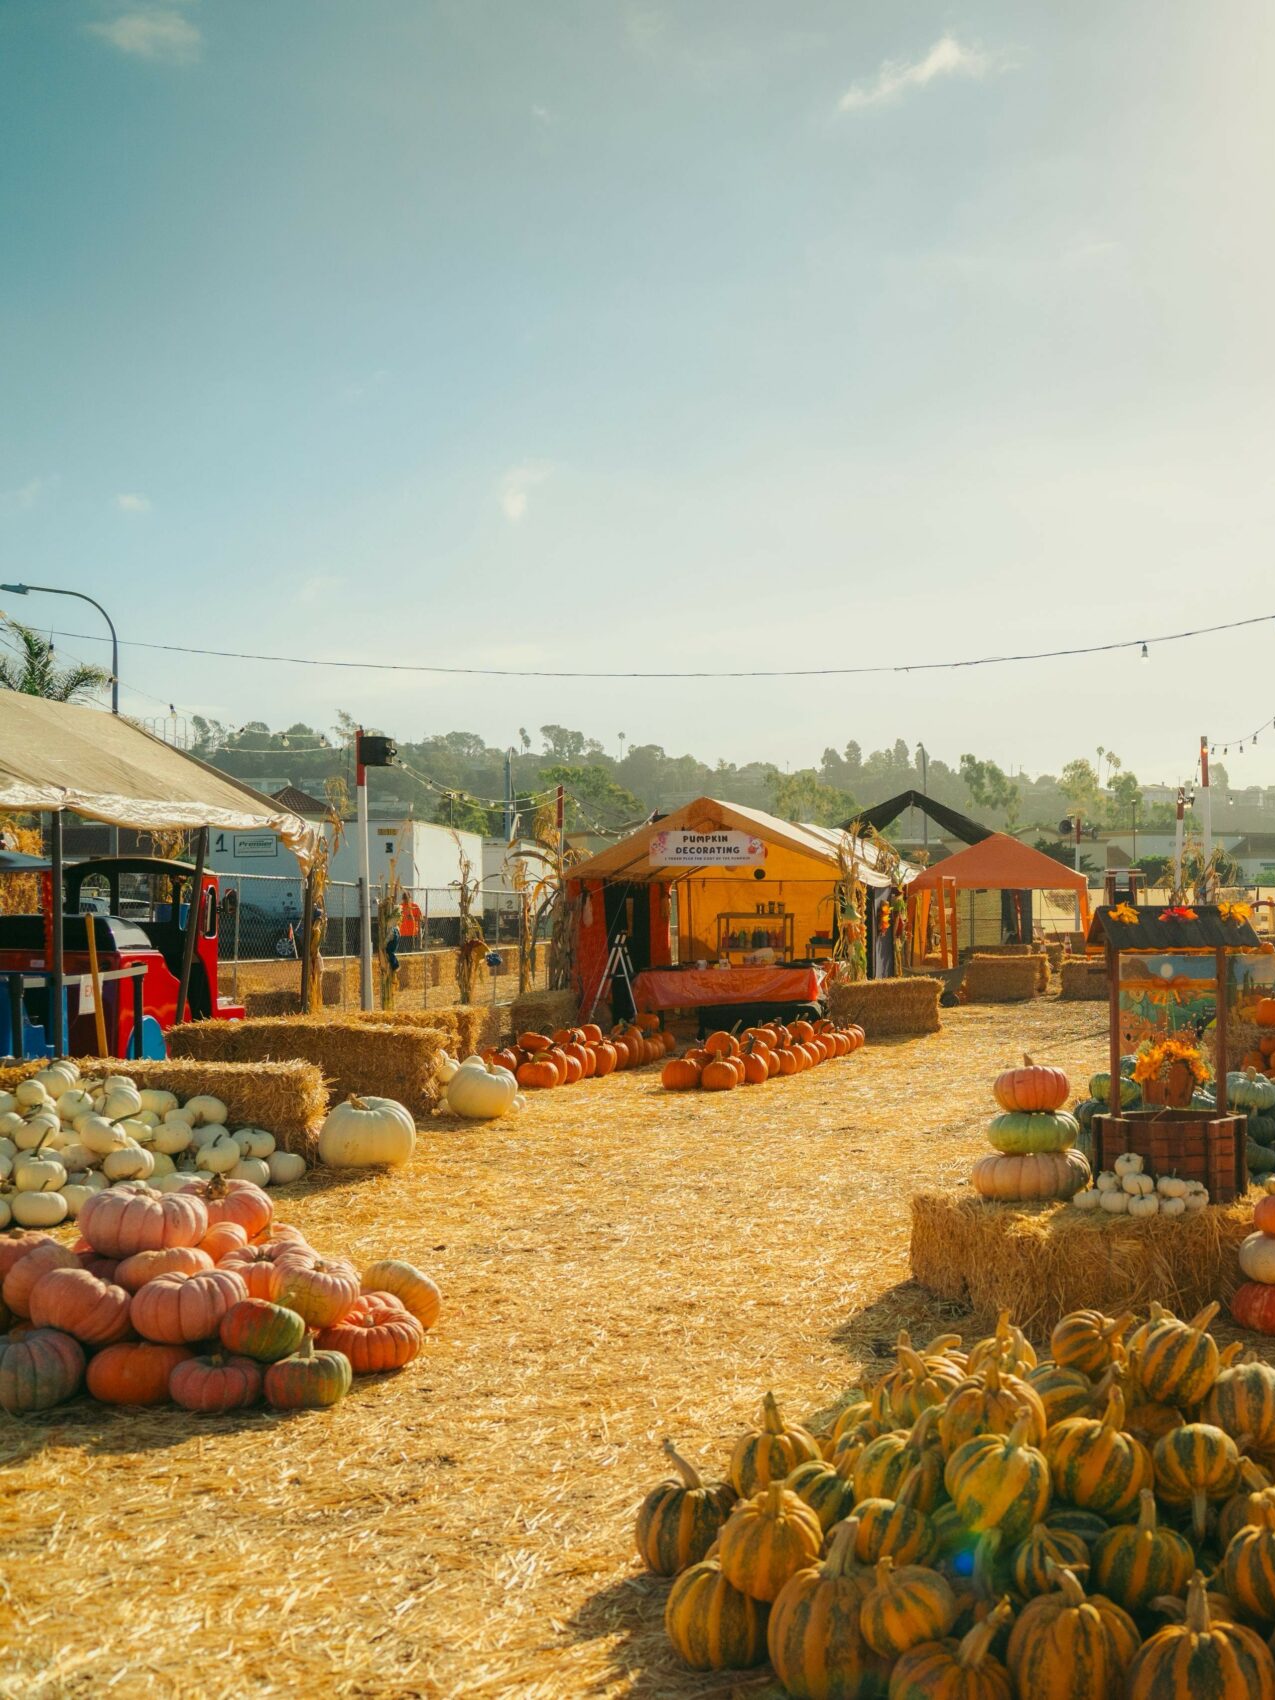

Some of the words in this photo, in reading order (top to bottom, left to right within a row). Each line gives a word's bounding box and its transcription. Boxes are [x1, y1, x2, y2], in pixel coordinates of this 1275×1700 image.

[215, 833, 228, 853] 1
[683, 835, 729, 843] PUMPKIN
[676, 846, 740, 854] DECORATING
[506, 900, 513, 909] 2
